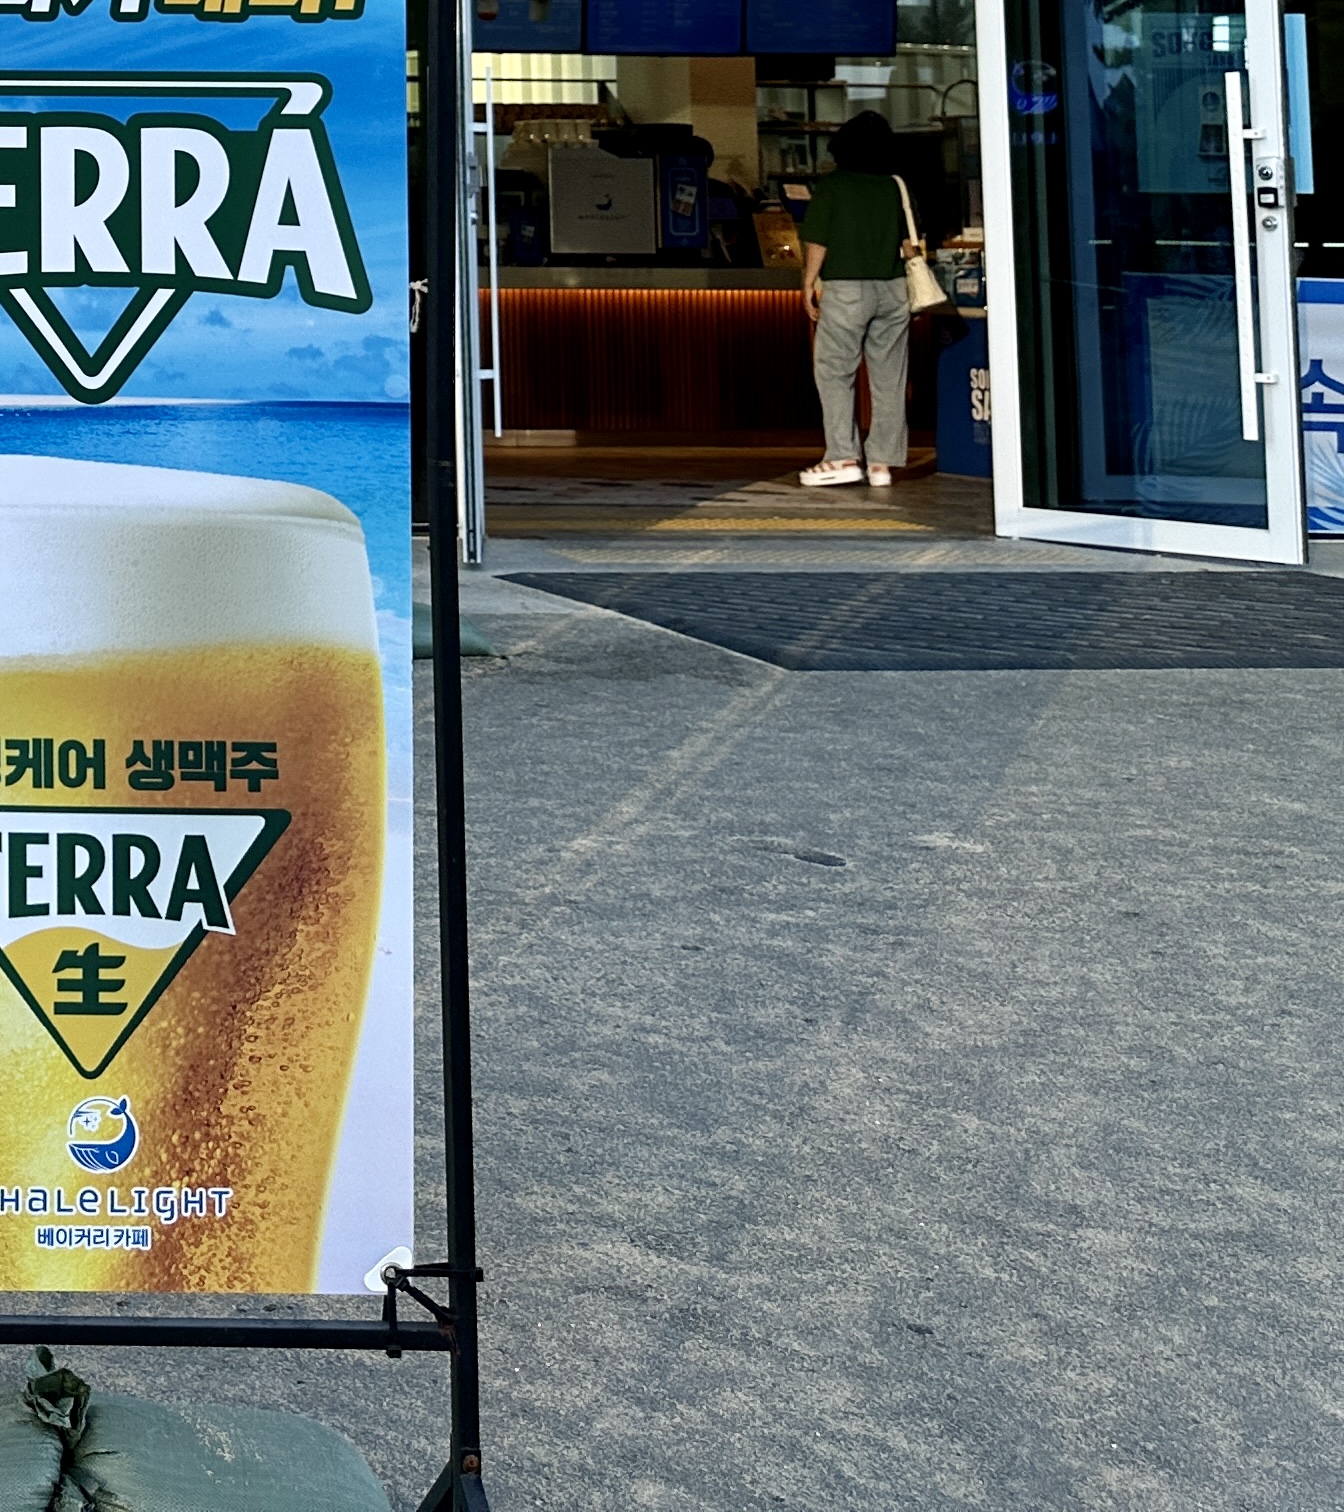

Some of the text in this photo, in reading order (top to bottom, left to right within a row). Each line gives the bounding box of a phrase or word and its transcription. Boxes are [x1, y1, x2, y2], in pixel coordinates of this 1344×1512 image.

[125, 738, 280, 792] 생맥주
[52, 942, 128, 1016] 生
[35, 1225, 150, 1248] 베이커리 카페
